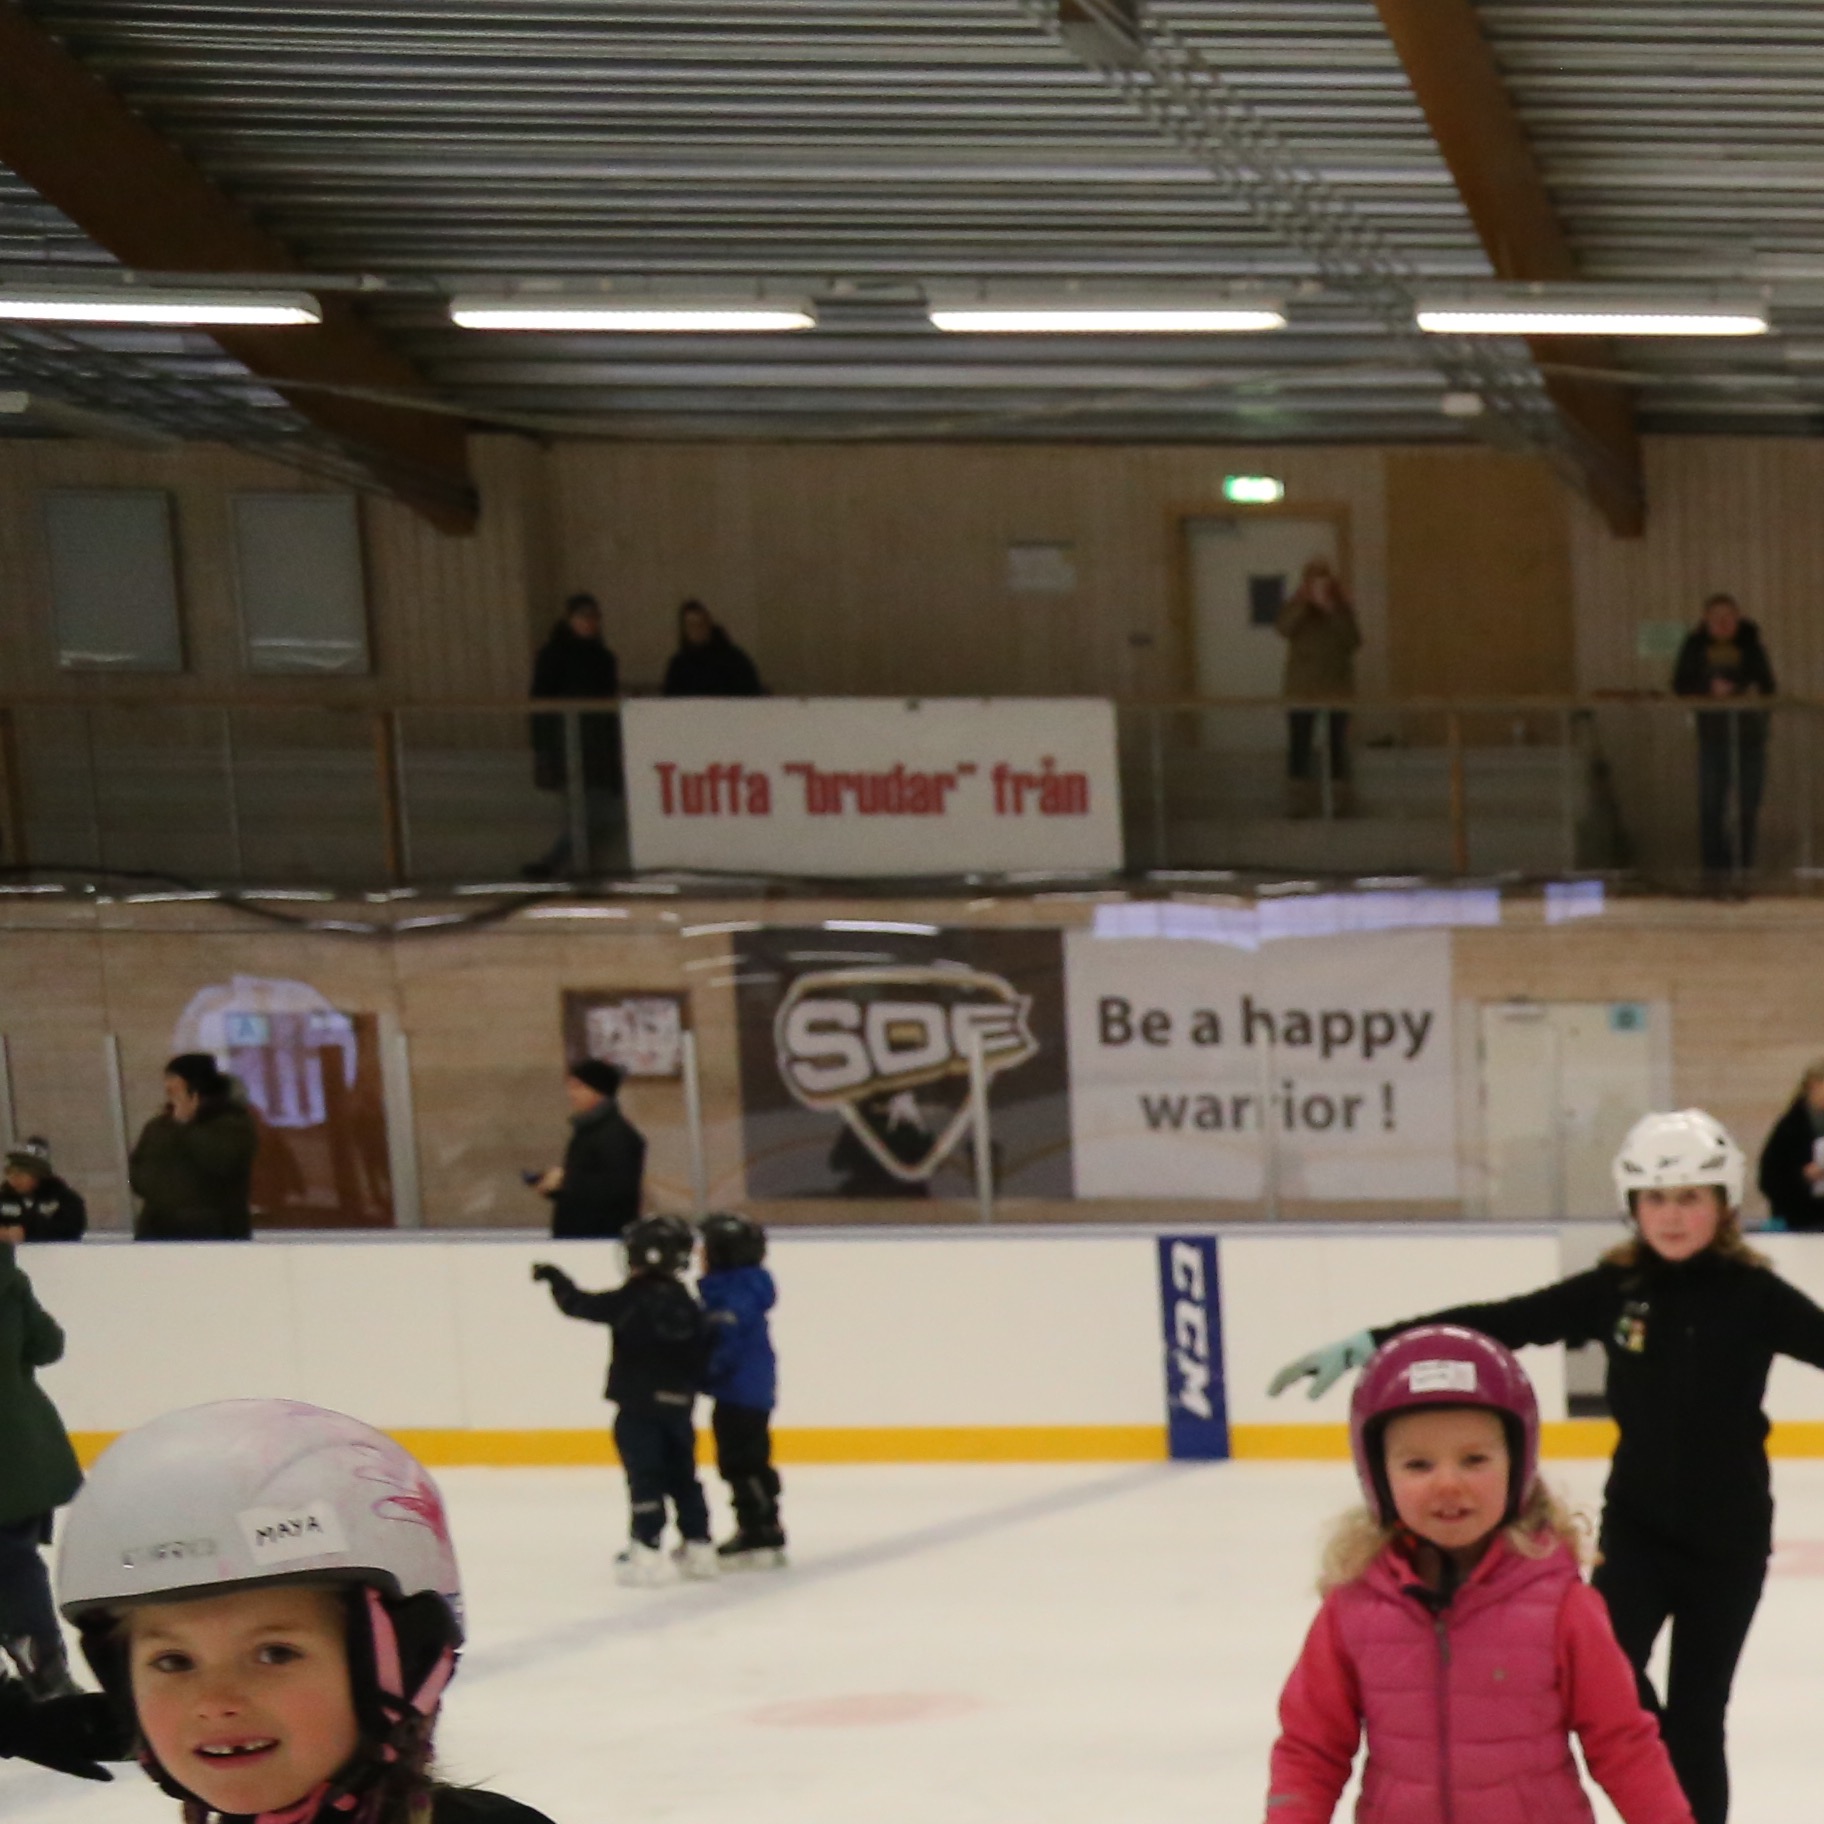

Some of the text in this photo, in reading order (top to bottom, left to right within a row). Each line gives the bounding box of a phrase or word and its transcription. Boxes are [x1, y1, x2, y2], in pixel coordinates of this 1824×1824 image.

[654, 755, 1090, 817] Tuffa "brudar" från
[1098, 994, 1433, 1061] Be a happy
[1171, 1240, 1214, 1420] CCM
[254, 1515, 324, 1547] MAYA
